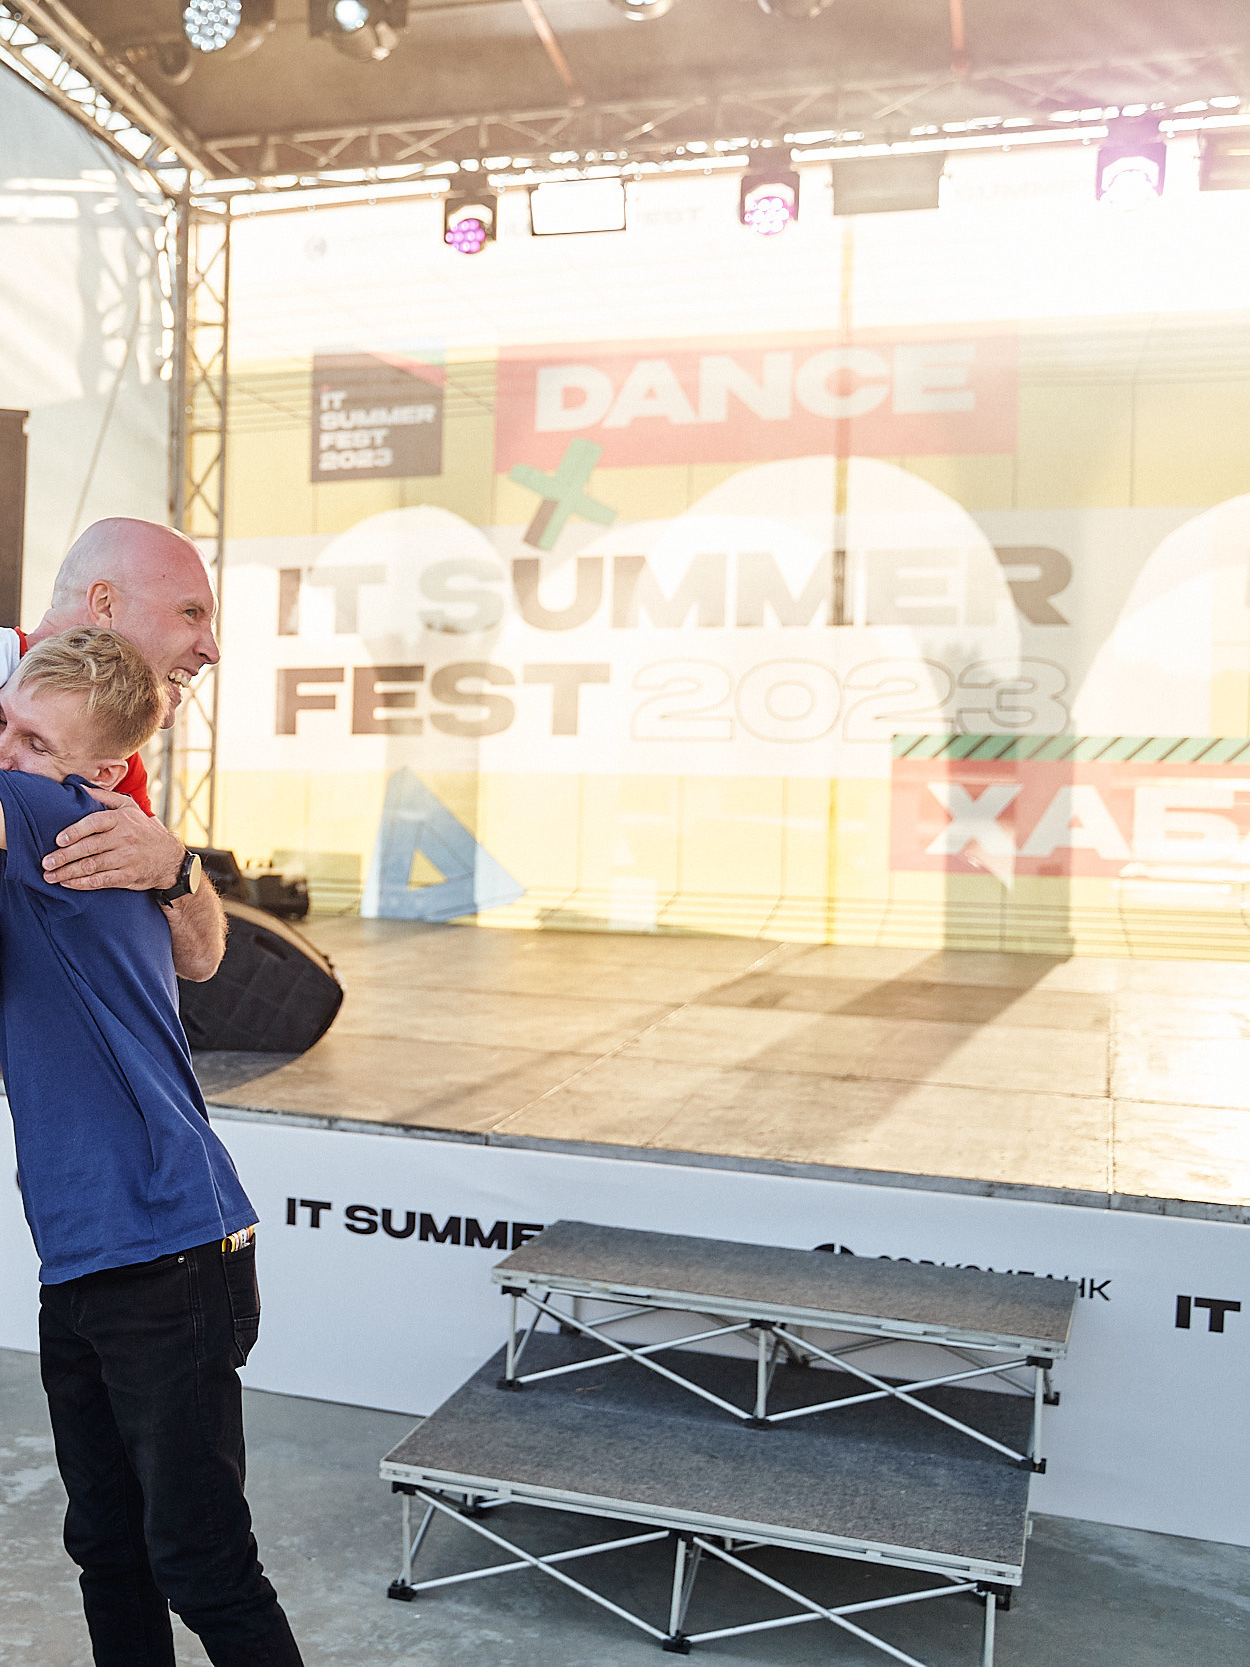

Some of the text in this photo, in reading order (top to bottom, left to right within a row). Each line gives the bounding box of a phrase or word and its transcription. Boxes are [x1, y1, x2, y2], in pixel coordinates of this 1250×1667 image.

[535, 343, 976, 433] DANCE
[318, 427, 391, 450] FEST
[320, 405, 437, 430] SUMMER
[319, 448, 393, 470] 2023
[277, 546, 1073, 636] IT SUMMER
[275, 656, 1071, 743] FEST 2023
[925, 779, 1250, 862] ХАБ
[285, 1197, 547, 1251] IT SUMME
[1175, 1295, 1241, 1333] IT
